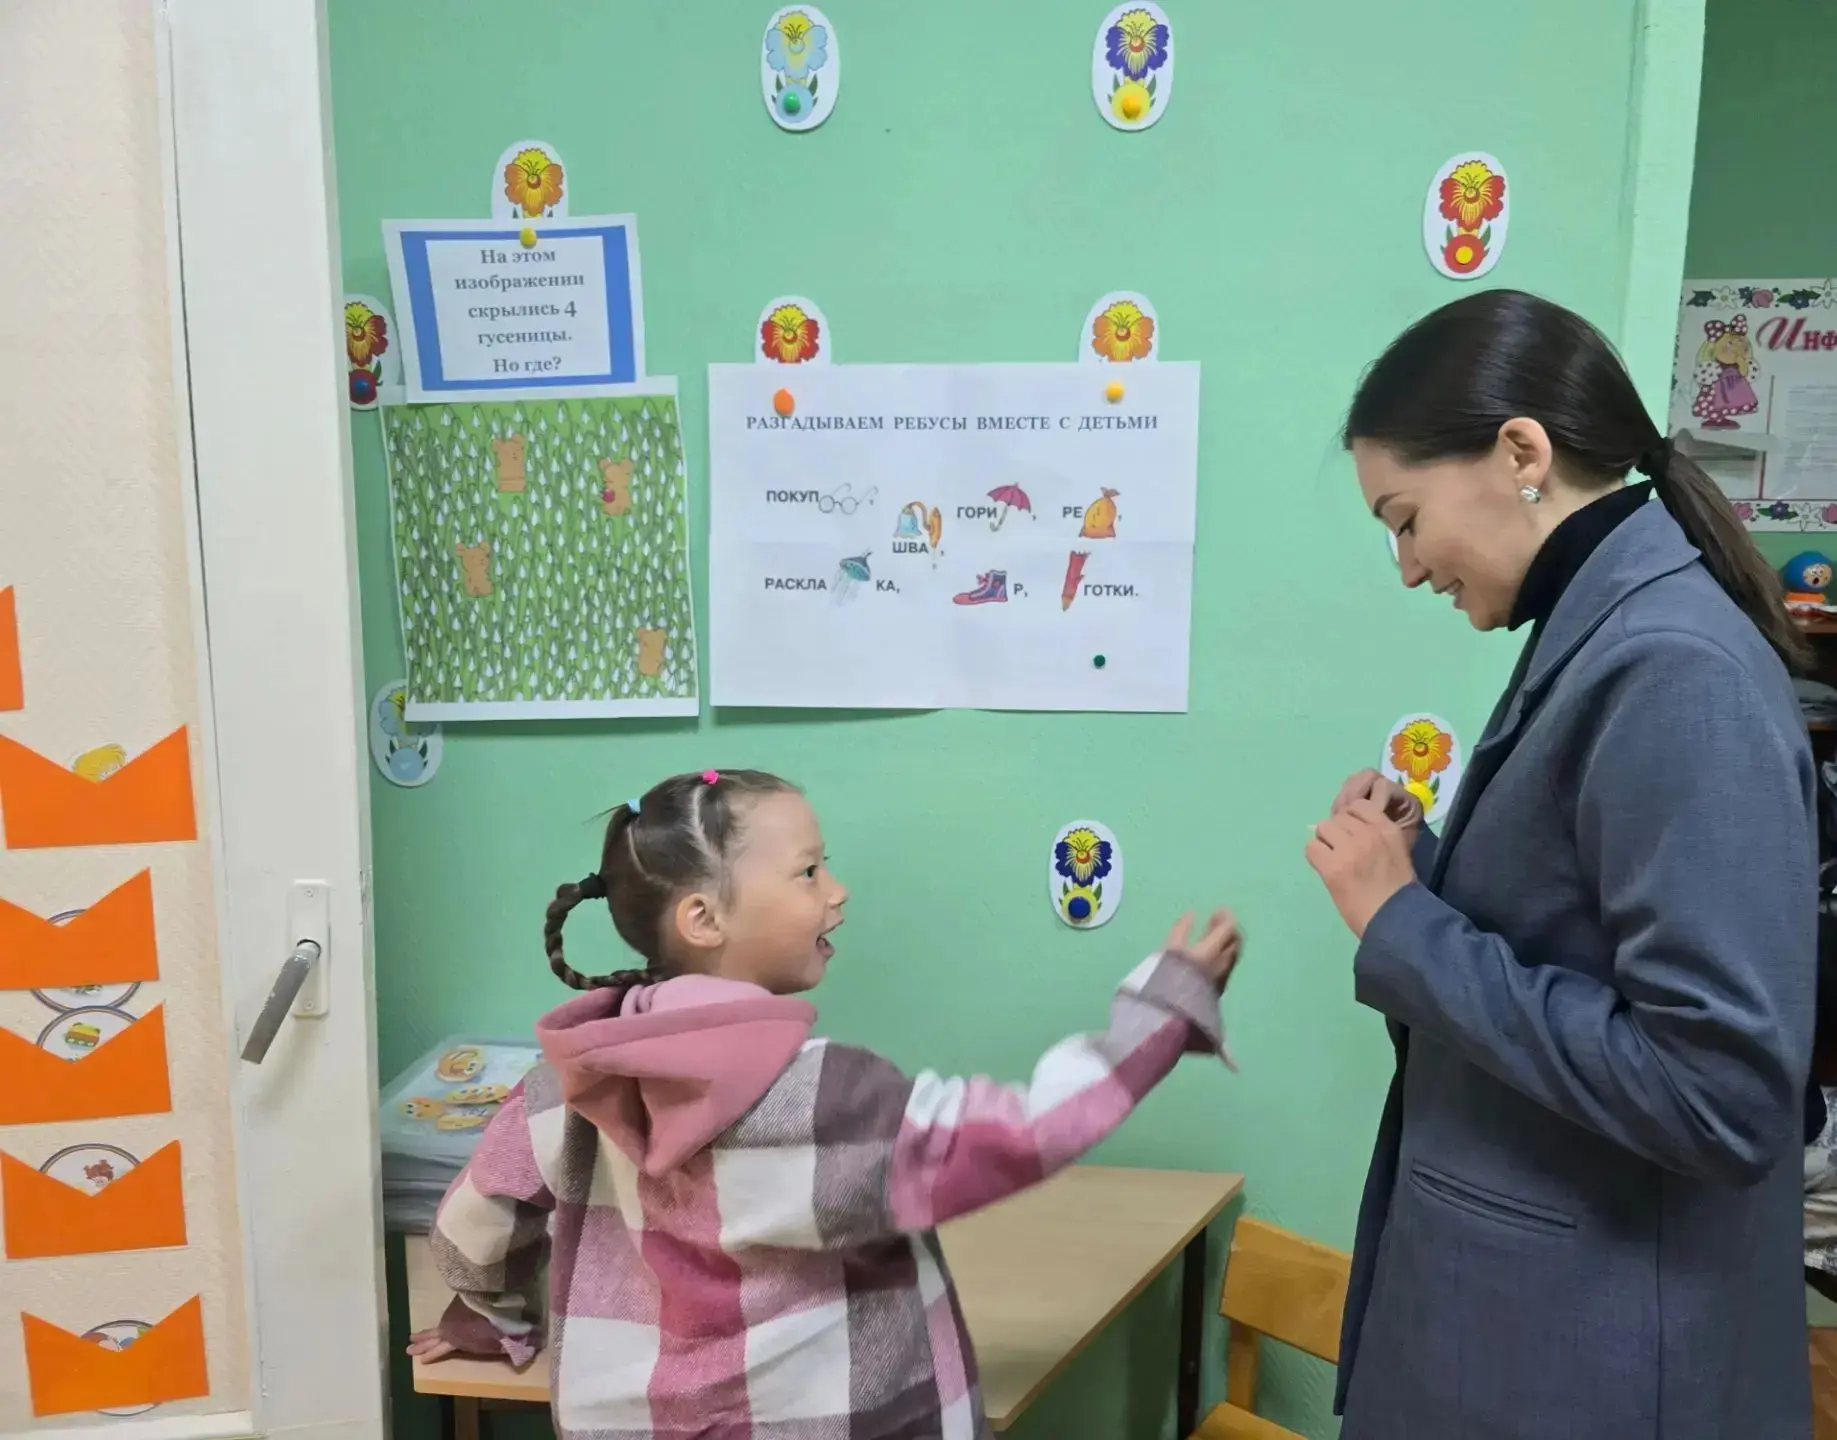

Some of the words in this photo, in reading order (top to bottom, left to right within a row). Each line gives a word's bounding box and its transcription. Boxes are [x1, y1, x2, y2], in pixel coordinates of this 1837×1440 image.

[480, 249, 507, 264] На
[512, 250, 556, 264] этом
[455, 274, 584, 292] изображении
[468, 304, 560, 321] скрылись
[564, 301, 577, 317] 4
[478, 331, 572, 347] гусеницы.
[493, 359, 519, 373] Но
[525, 356, 562, 374] где?
[894, 416, 967, 430] РЕБУСЫ
[977, 416, 1050, 430] ВМЕСТЕ
[1059, 416, 1071, 430] С
[1078, 415, 1158, 432] ДЕТЬМИ
[766, 490, 819, 503] ПОКУП
[765, 578, 827, 590] РАСКЛА
[1083, 584, 1138, 597] ГОТКИ.
